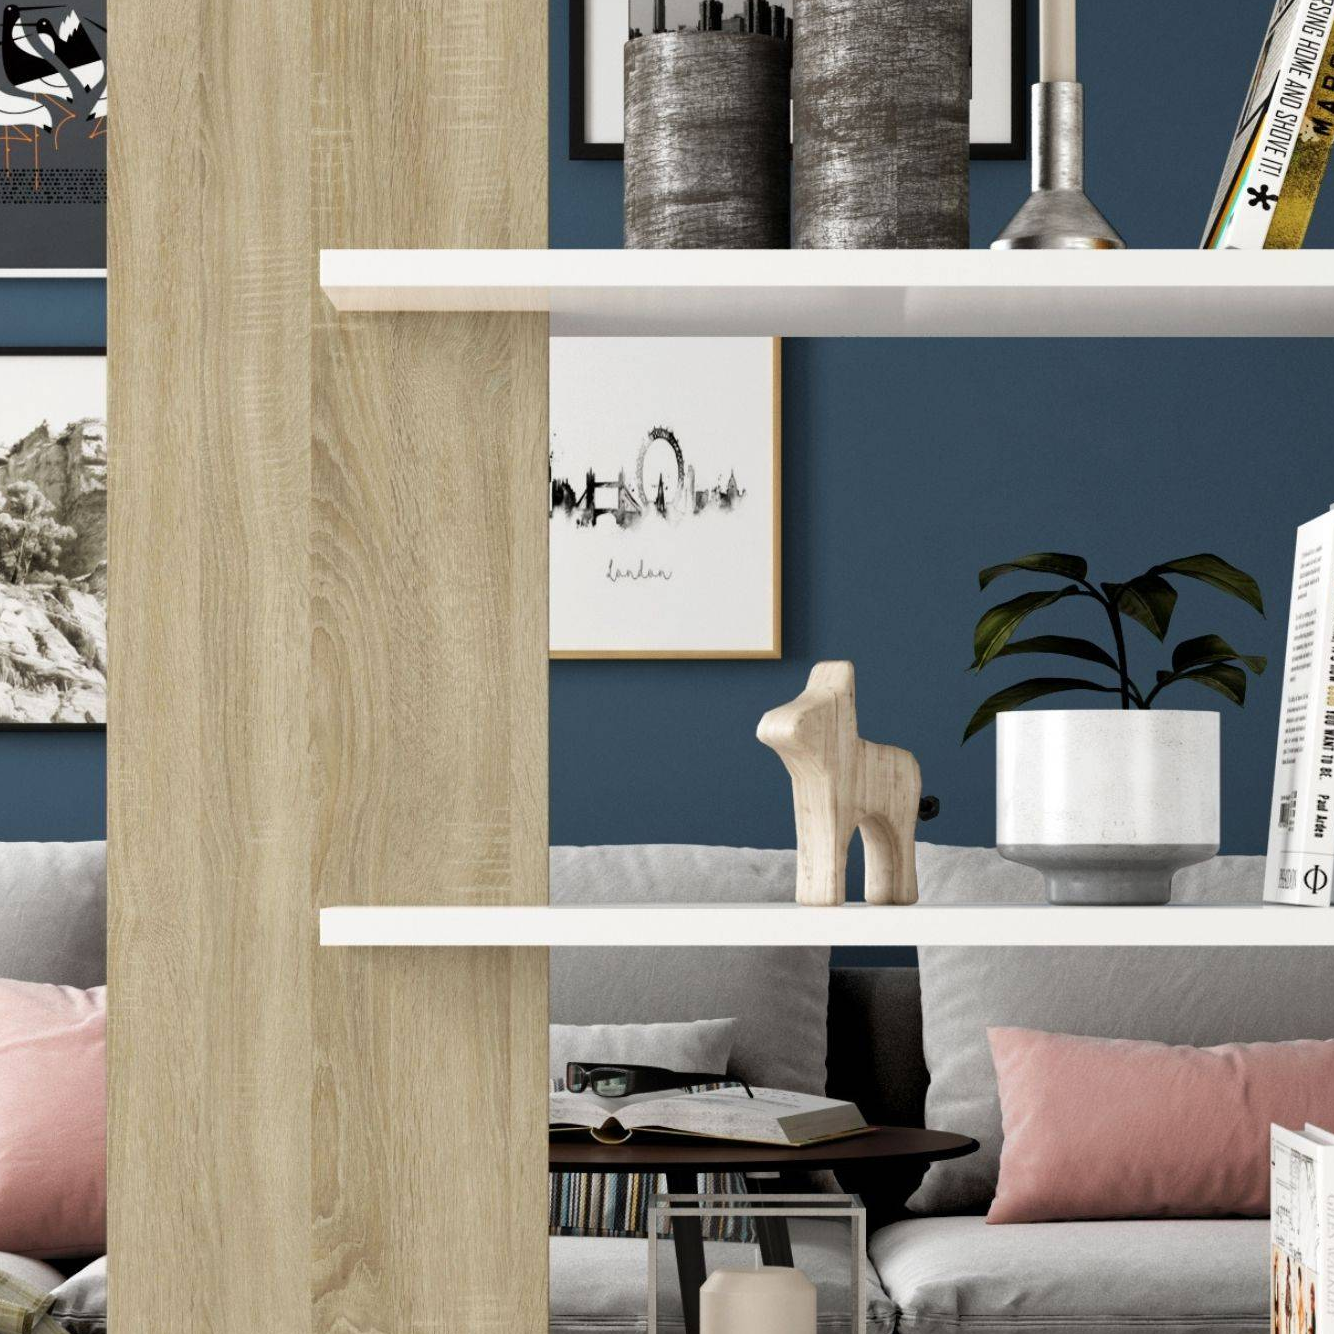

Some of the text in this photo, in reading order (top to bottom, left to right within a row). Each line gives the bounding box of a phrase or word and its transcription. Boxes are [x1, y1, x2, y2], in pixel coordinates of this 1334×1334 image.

[1288, 37, 1321, 80] HOME
[1279, 78, 1307, 110] AND
[1264, 109, 1298, 158] SHOVE
[1258, 157, 1283, 177] IT!
[1320, 754, 1334, 765] TO
[1313, 793, 1330, 839] Paul Arden
